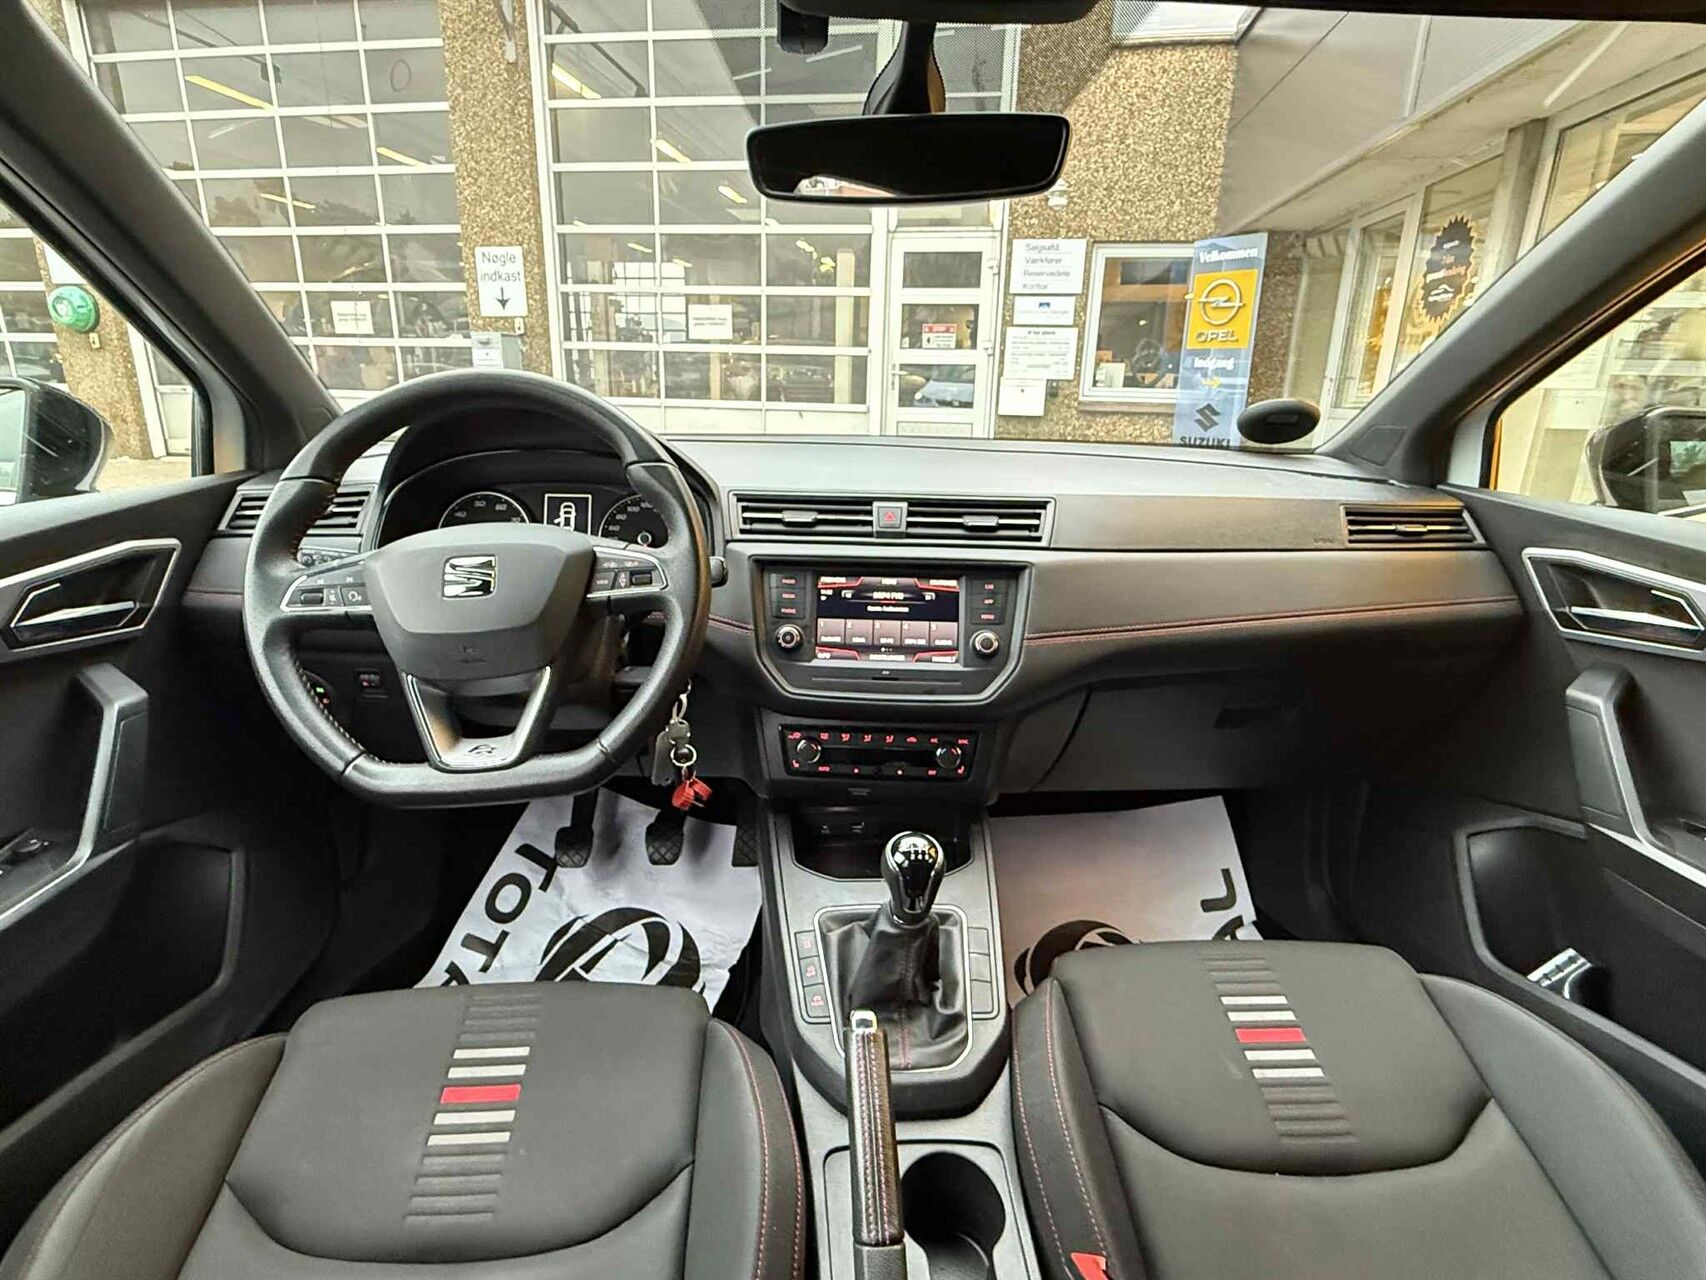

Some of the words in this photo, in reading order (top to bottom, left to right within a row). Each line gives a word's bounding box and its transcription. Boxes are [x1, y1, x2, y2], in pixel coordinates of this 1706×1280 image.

[481, 251, 516, 267] Nøgle
[480, 270, 521, 282] indkast
[1195, 329, 1239, 343] OPEL
[1180, 436, 1230, 448] SUZUKI
